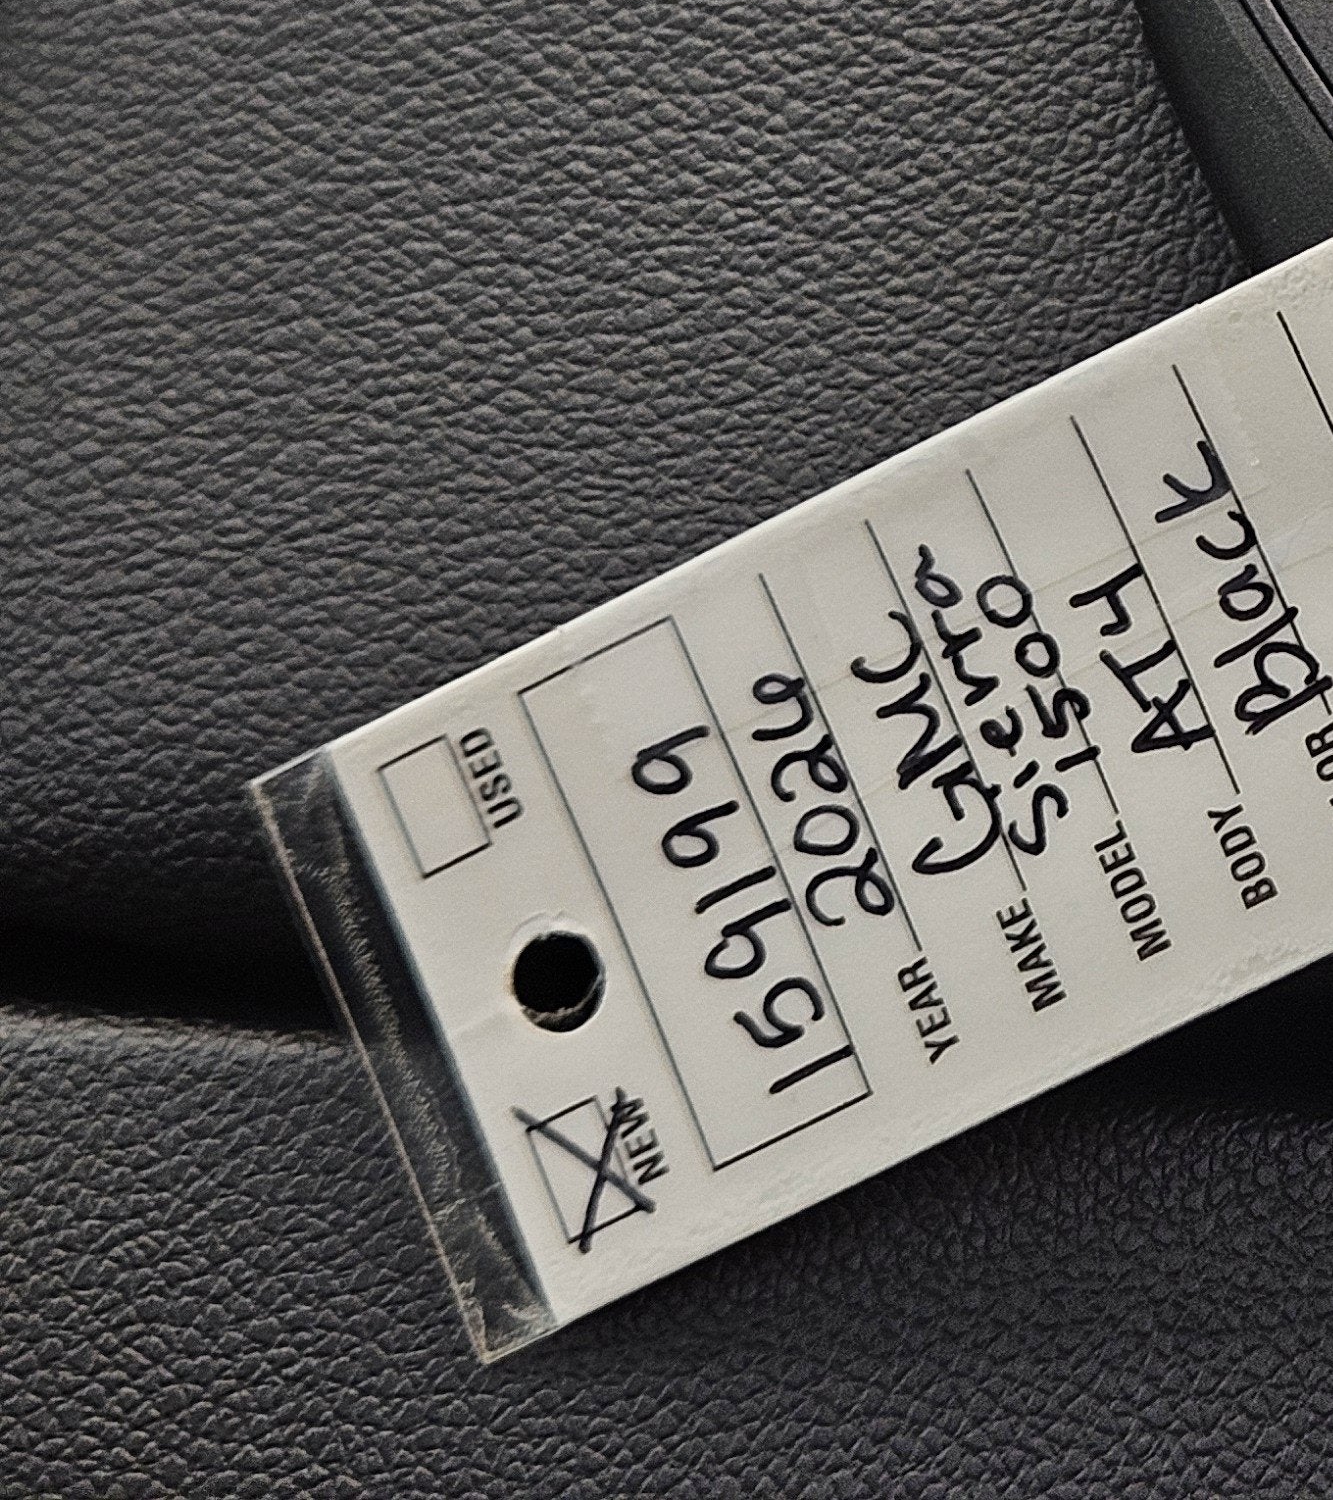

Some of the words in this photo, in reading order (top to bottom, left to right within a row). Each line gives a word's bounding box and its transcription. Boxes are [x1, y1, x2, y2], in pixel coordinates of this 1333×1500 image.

[914, 544, 1068, 856] Sierra
[975, 575, 1101, 773] 1500
[1069, 563, 1216, 753] AT4
[460, 727, 523, 828] USED
[752, 673, 895, 926] 2026
[851, 609, 1002, 875] GMC
[632, 724, 854, 1094] 159199
[1094, 819, 1174, 962] MODEL
[1207, 803, 1279, 910] BODY
[897, 957, 961, 1065] YEAR
[996, 897, 1066, 1012] MAKE
[611, 1098, 670, 1185] NEW
